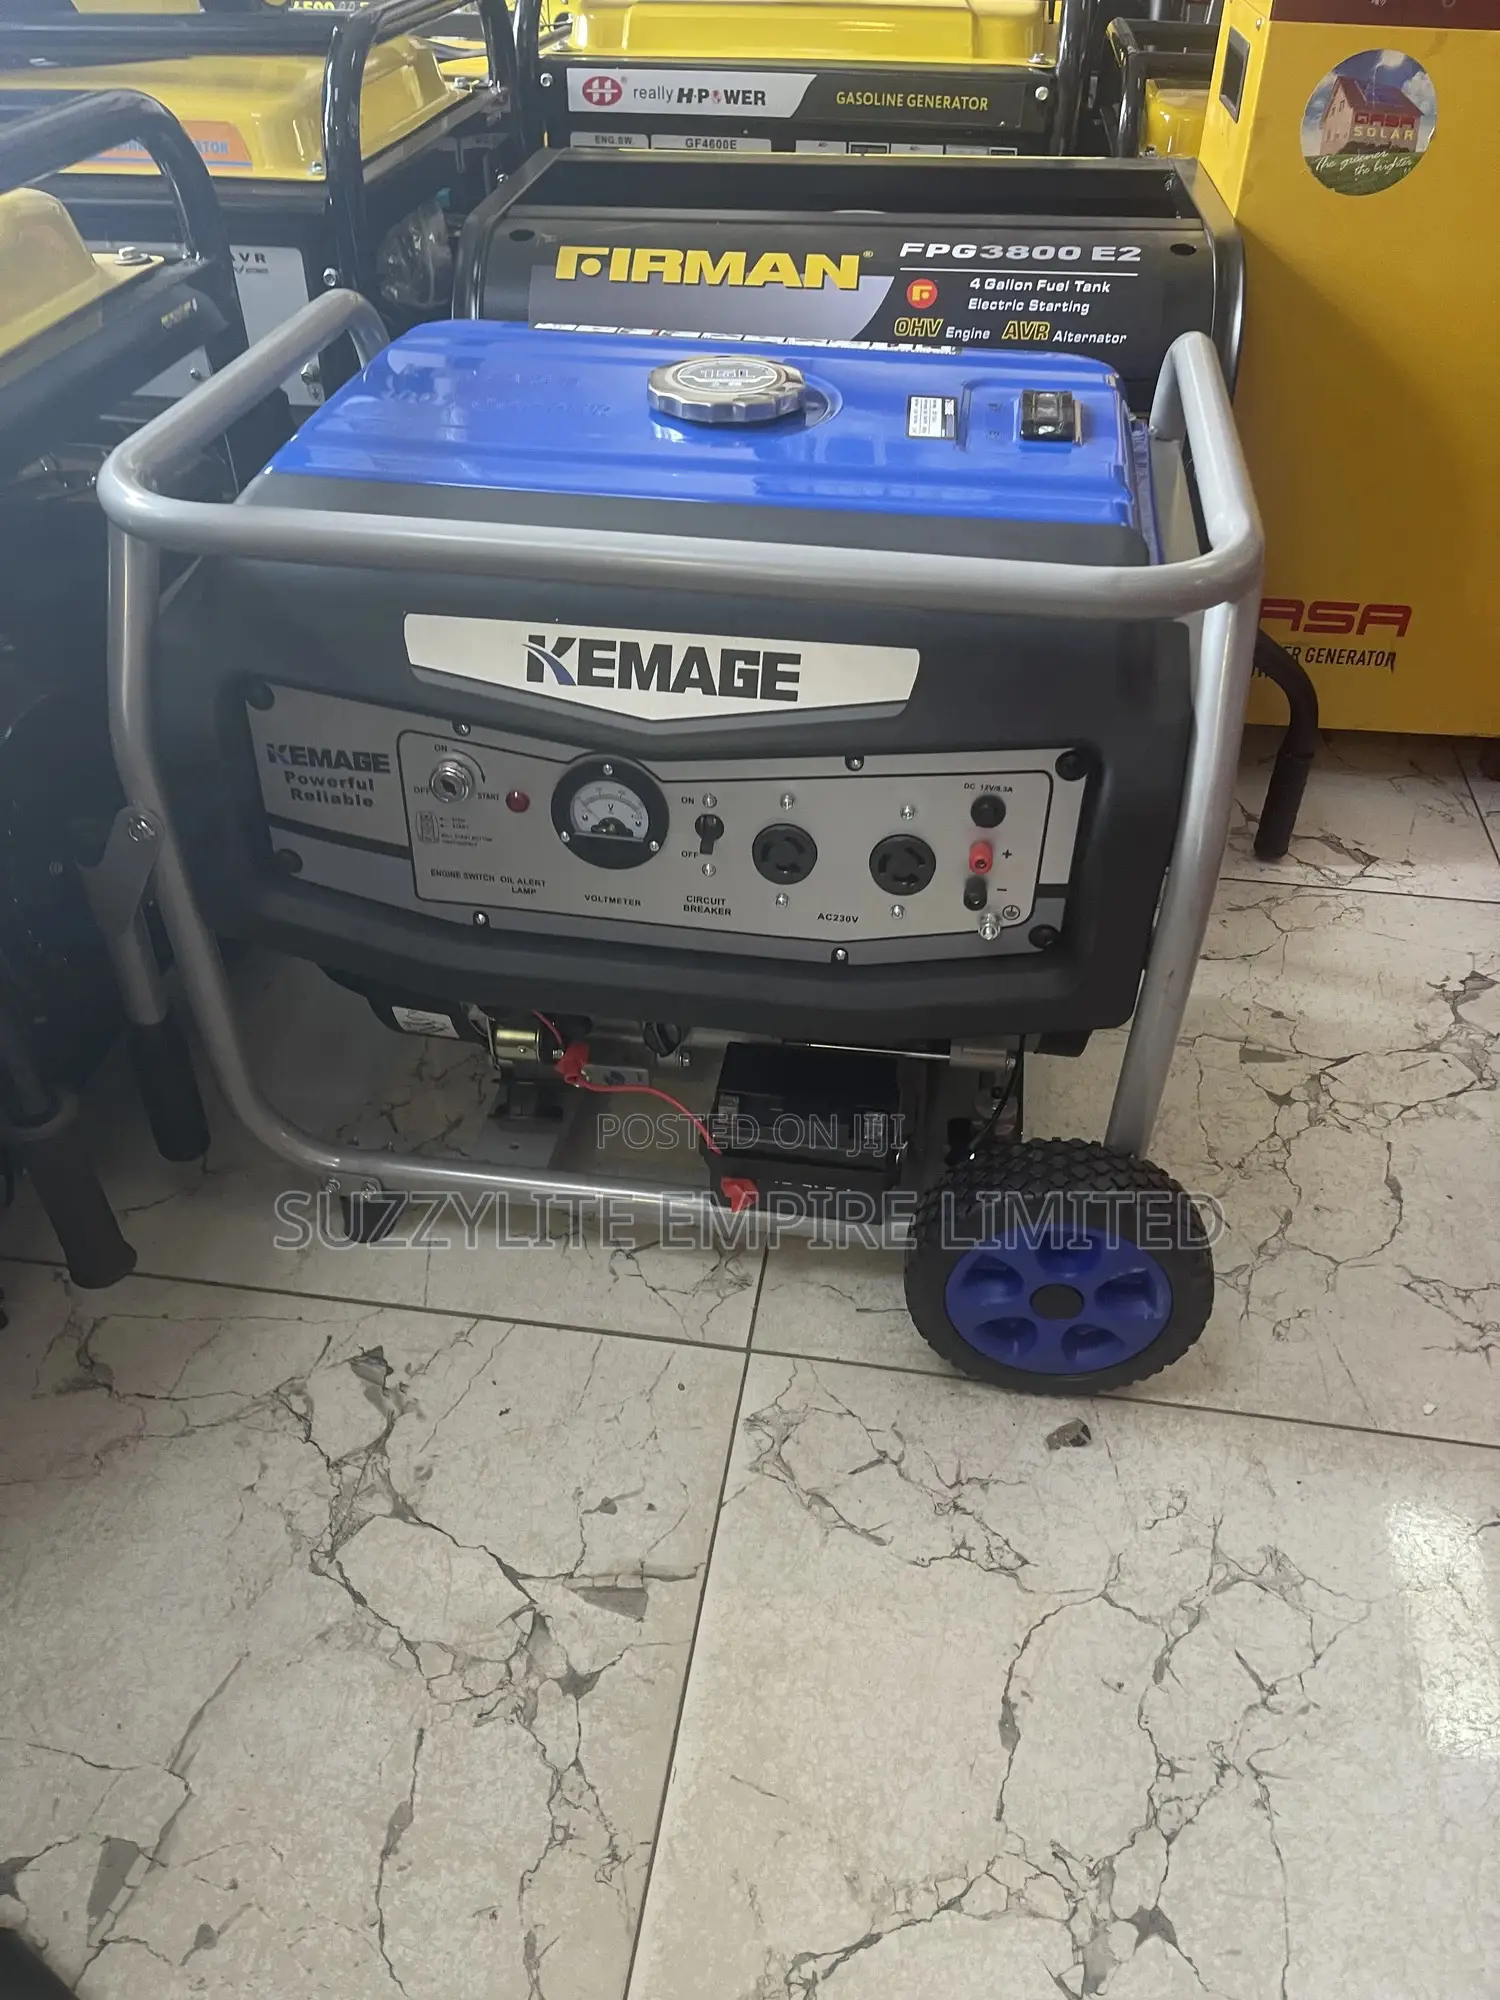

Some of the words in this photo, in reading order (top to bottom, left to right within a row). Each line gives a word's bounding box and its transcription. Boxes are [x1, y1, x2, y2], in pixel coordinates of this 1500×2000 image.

[633, 86, 673, 103] really
[836, 91, 904, 107] GASOLINE
[907, 93, 989, 112] GENERATOR
[1353, 126, 1415, 141] SOLAR
[685, 138, 737, 150] GF4600E
[900, 242, 1081, 261] FPG3800
[1092, 246, 1142, 261] E2
[555, 245, 860, 291] FIRMAN
[969, 278, 981, 290] 4
[984, 279, 1033, 292] Gallon
[1036, 281, 1069, 292] Fuel
[1075, 280, 1111, 293] Tank
[968, 298, 1024, 312] Electric
[1028, 300, 1090, 316] Starting
[894, 317, 943, 337] OHV
[945, 326, 990, 341] Engine
[1001, 321, 1050, 341] AVR
[1052, 330, 1127, 344] Alternator
[1304, 648, 1396, 668] GENERATOR
[522, 634, 801, 702] KEMAGE
[434, 743, 448, 752] ON
[266, 743, 391, 774] KEMAGE
[284, 770, 375, 792] Powerful
[290, 787, 374, 808] Reliable
[477, 792, 500, 801] START
[681, 796, 695, 805] ON
[681, 850, 698, 859] OFF
[430, 869, 460, 880] ENGINE
[463, 874, 495, 882] SWITCH
[500, 875, 514, 885] OIL
[517, 878, 546, 887] ALERT
[511, 885, 537, 895] LAMP
[584, 894, 641, 906] VOLTMETER
[686, 895, 726, 906] CIRCUIT
[683, 904, 732, 916] BREAKER
[817, 912, 859, 924] AC230V
